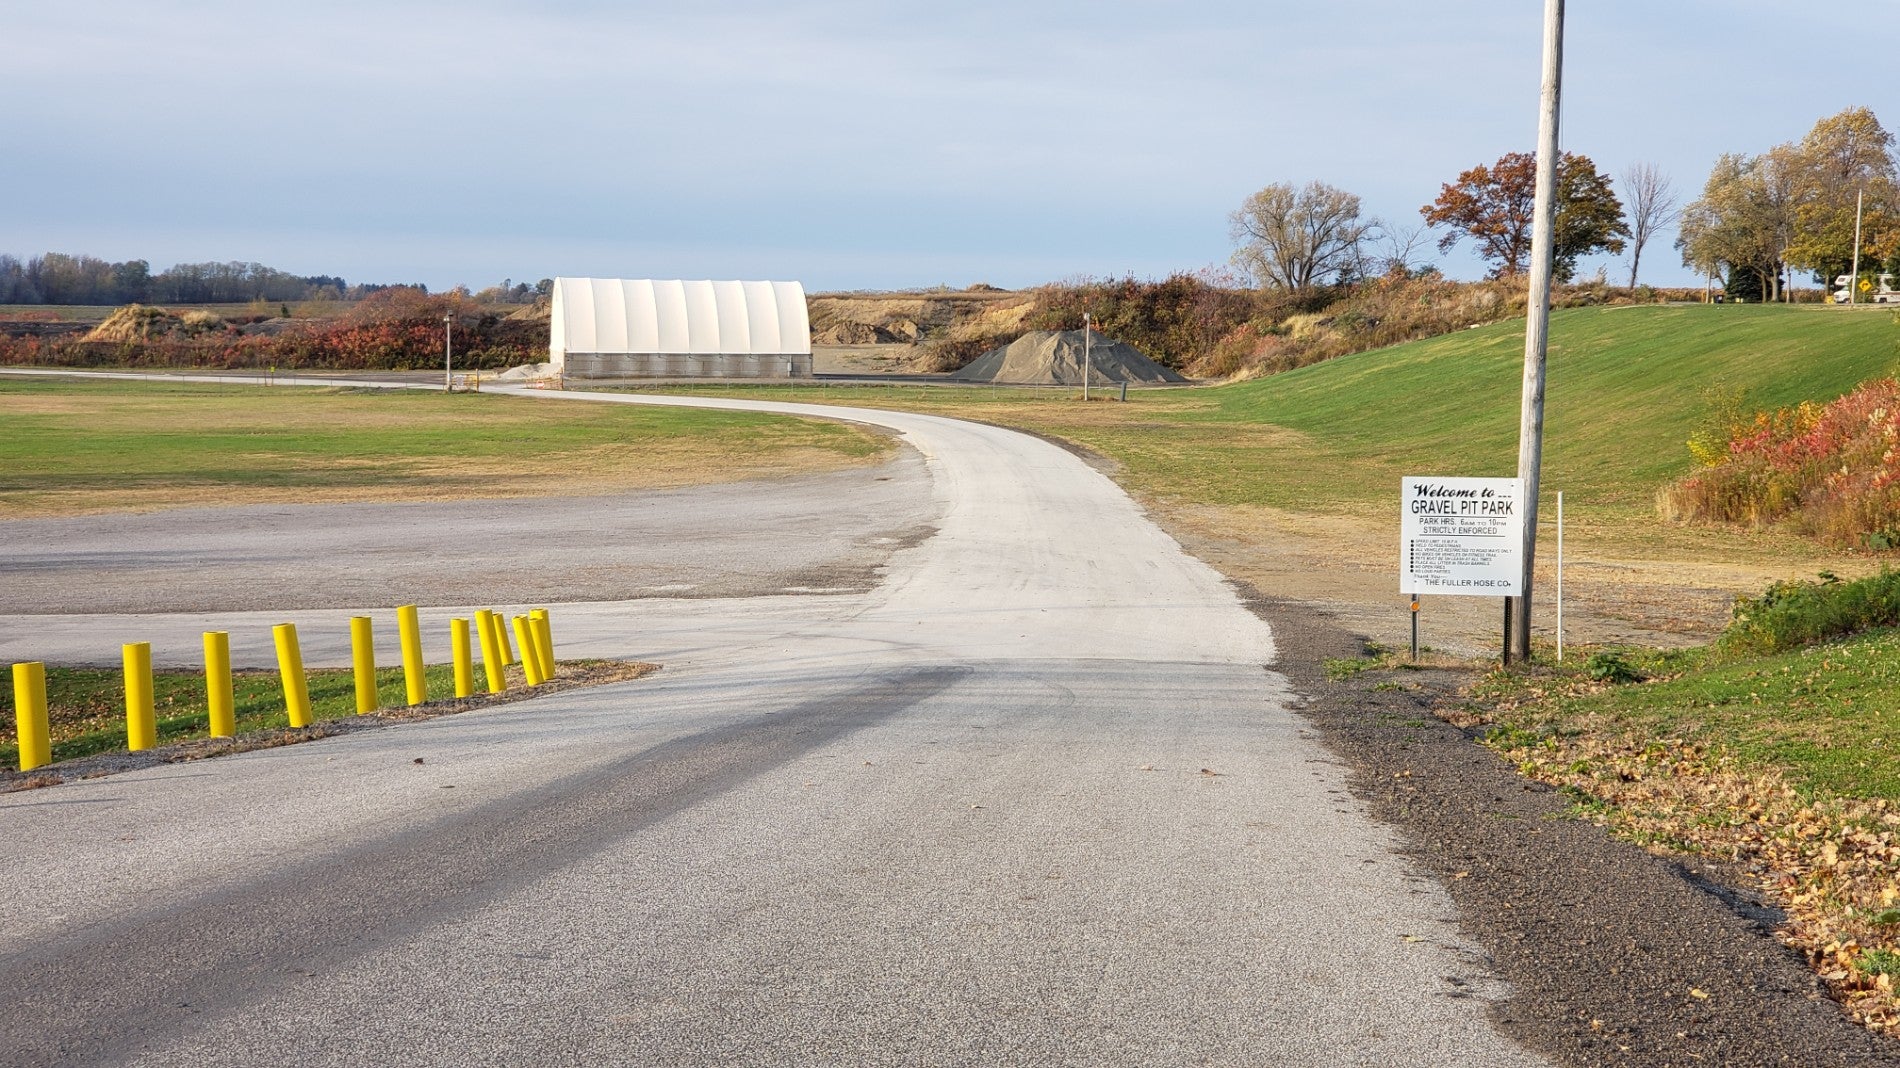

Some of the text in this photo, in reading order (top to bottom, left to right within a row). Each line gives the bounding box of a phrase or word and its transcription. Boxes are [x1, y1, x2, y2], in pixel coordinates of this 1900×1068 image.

[1414, 484, 1477, 498] Welcome
[1412, 500, 1513, 515] GRAVEL PIT PARK
